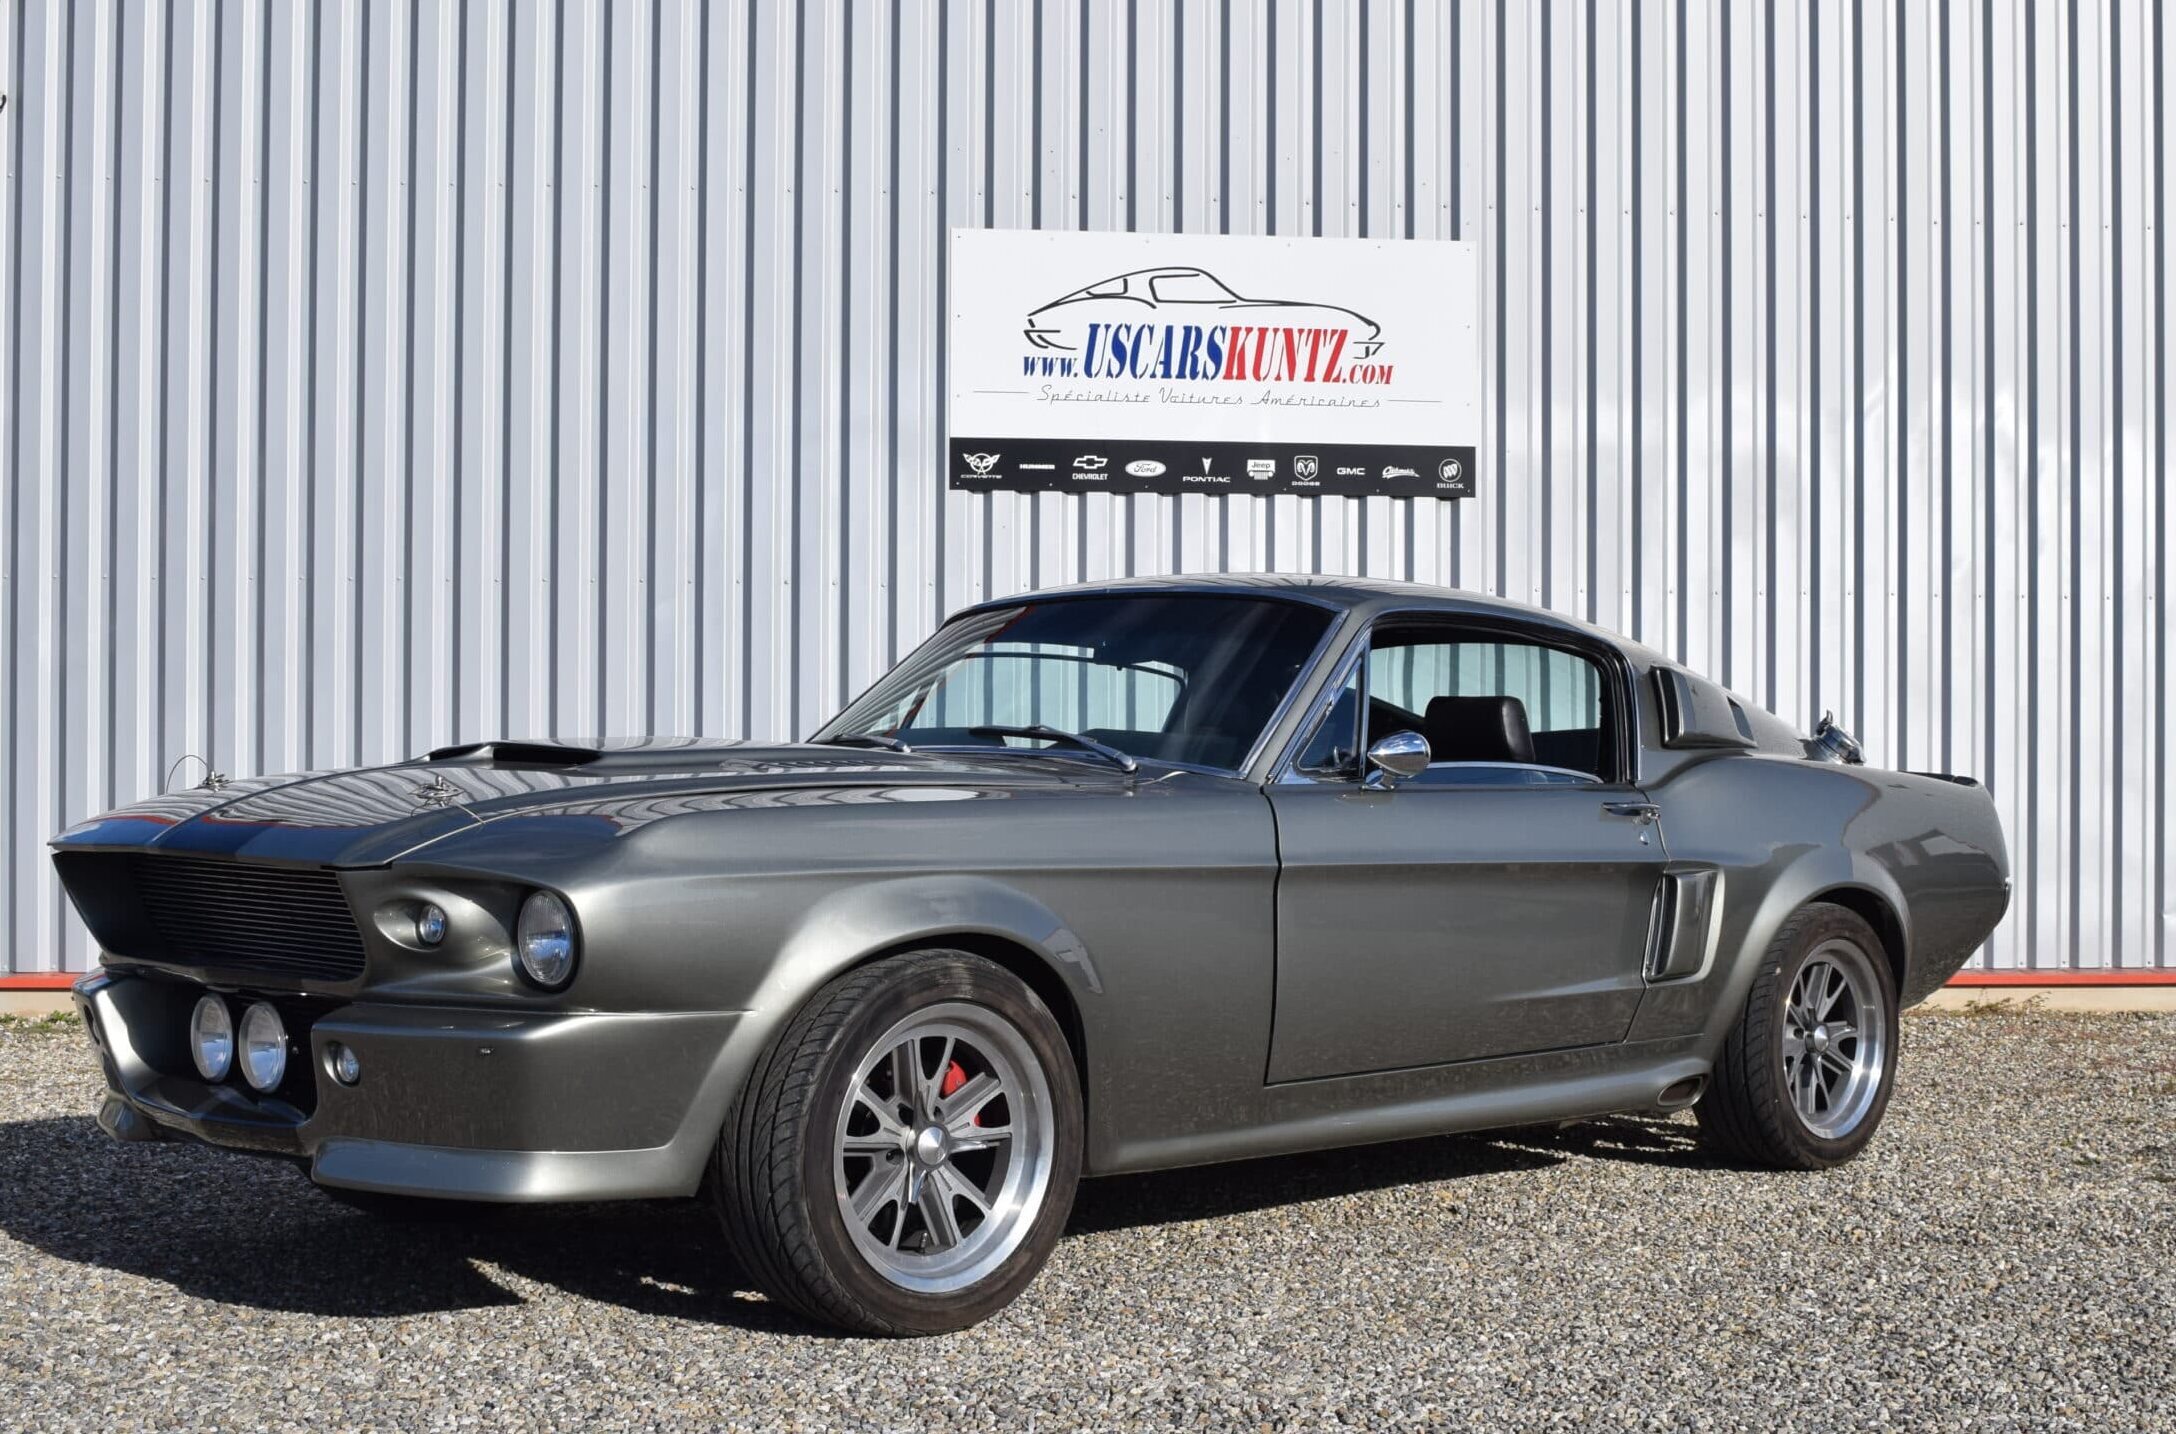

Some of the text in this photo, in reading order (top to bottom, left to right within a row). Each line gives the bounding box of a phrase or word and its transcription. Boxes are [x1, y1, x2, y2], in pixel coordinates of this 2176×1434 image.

[1037, 384, 1380, 408] Spécialiste Voitures Américaines
[1133, 463, 1157, 474] Ford
[1336, 467, 1366, 476] GMC
[1072, 473, 1109, 481] CHEVROLET
[1182, 475, 1231, 483] PONTIAC
